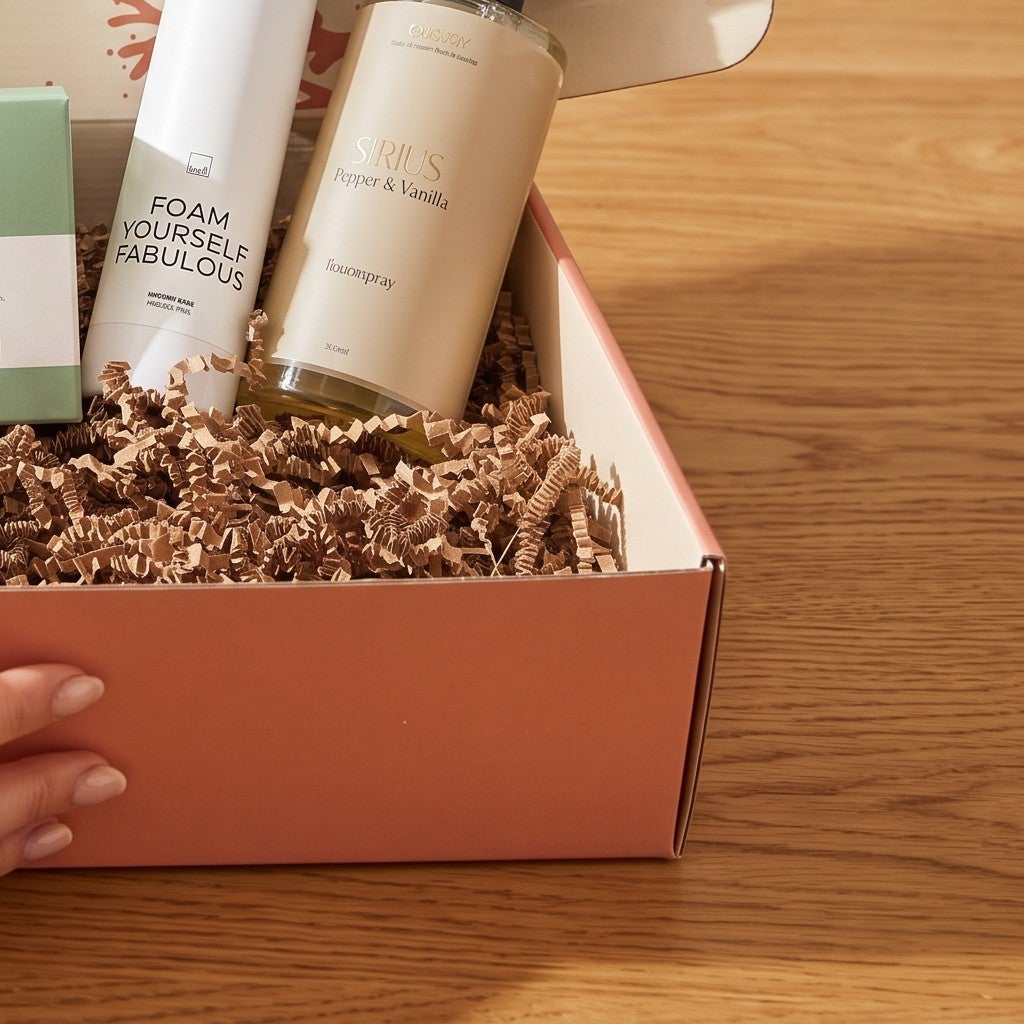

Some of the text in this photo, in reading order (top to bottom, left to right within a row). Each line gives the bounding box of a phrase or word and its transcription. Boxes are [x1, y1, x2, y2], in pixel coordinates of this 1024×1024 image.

[351, 136, 444, 182] SIRIUS
[334, 167, 449, 211] Pepper & Vanilla
[150, 195, 230, 231] FOAM
[123, 220, 249, 264] YOURSELF
[115, 244, 245, 292] FABULOUS
